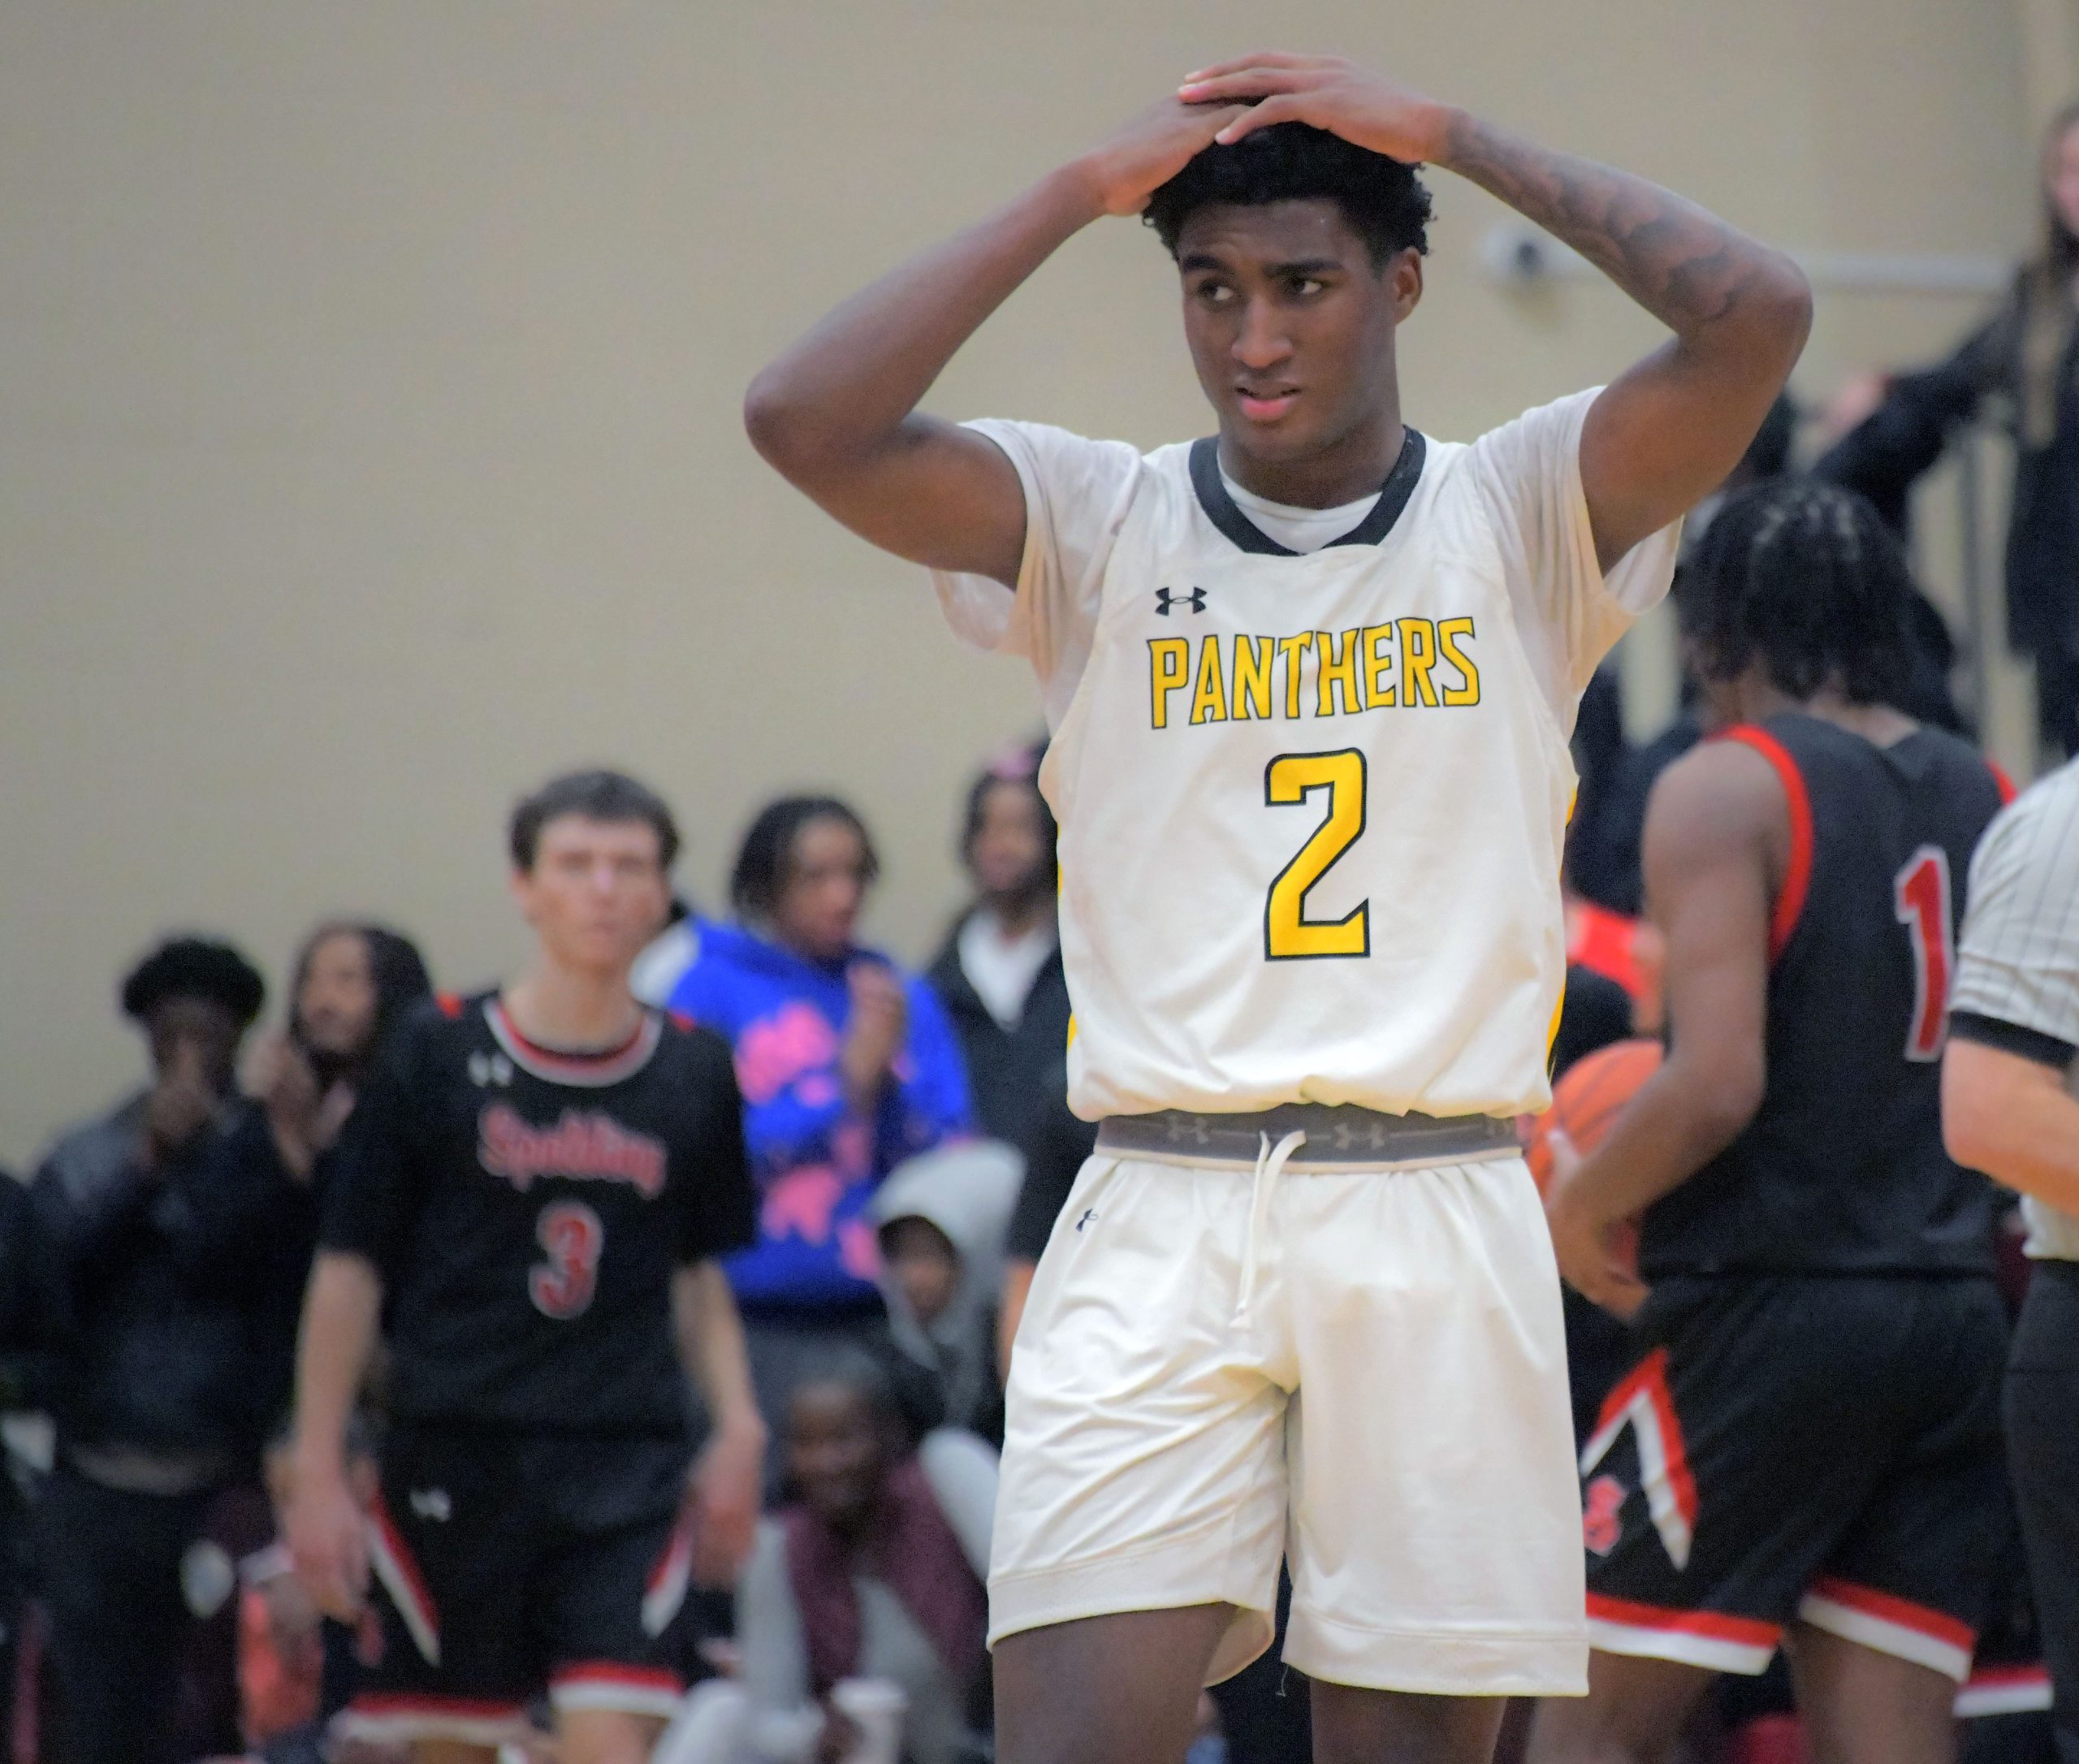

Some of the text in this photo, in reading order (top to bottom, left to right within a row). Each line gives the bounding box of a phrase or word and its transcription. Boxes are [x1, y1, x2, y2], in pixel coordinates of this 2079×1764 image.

[1147, 616, 1480, 729] PANTHERS
[1264, 747, 1371, 962] 2
[1895, 844, 1951, 1063] 1
[529, 1202, 603, 1320] 3
